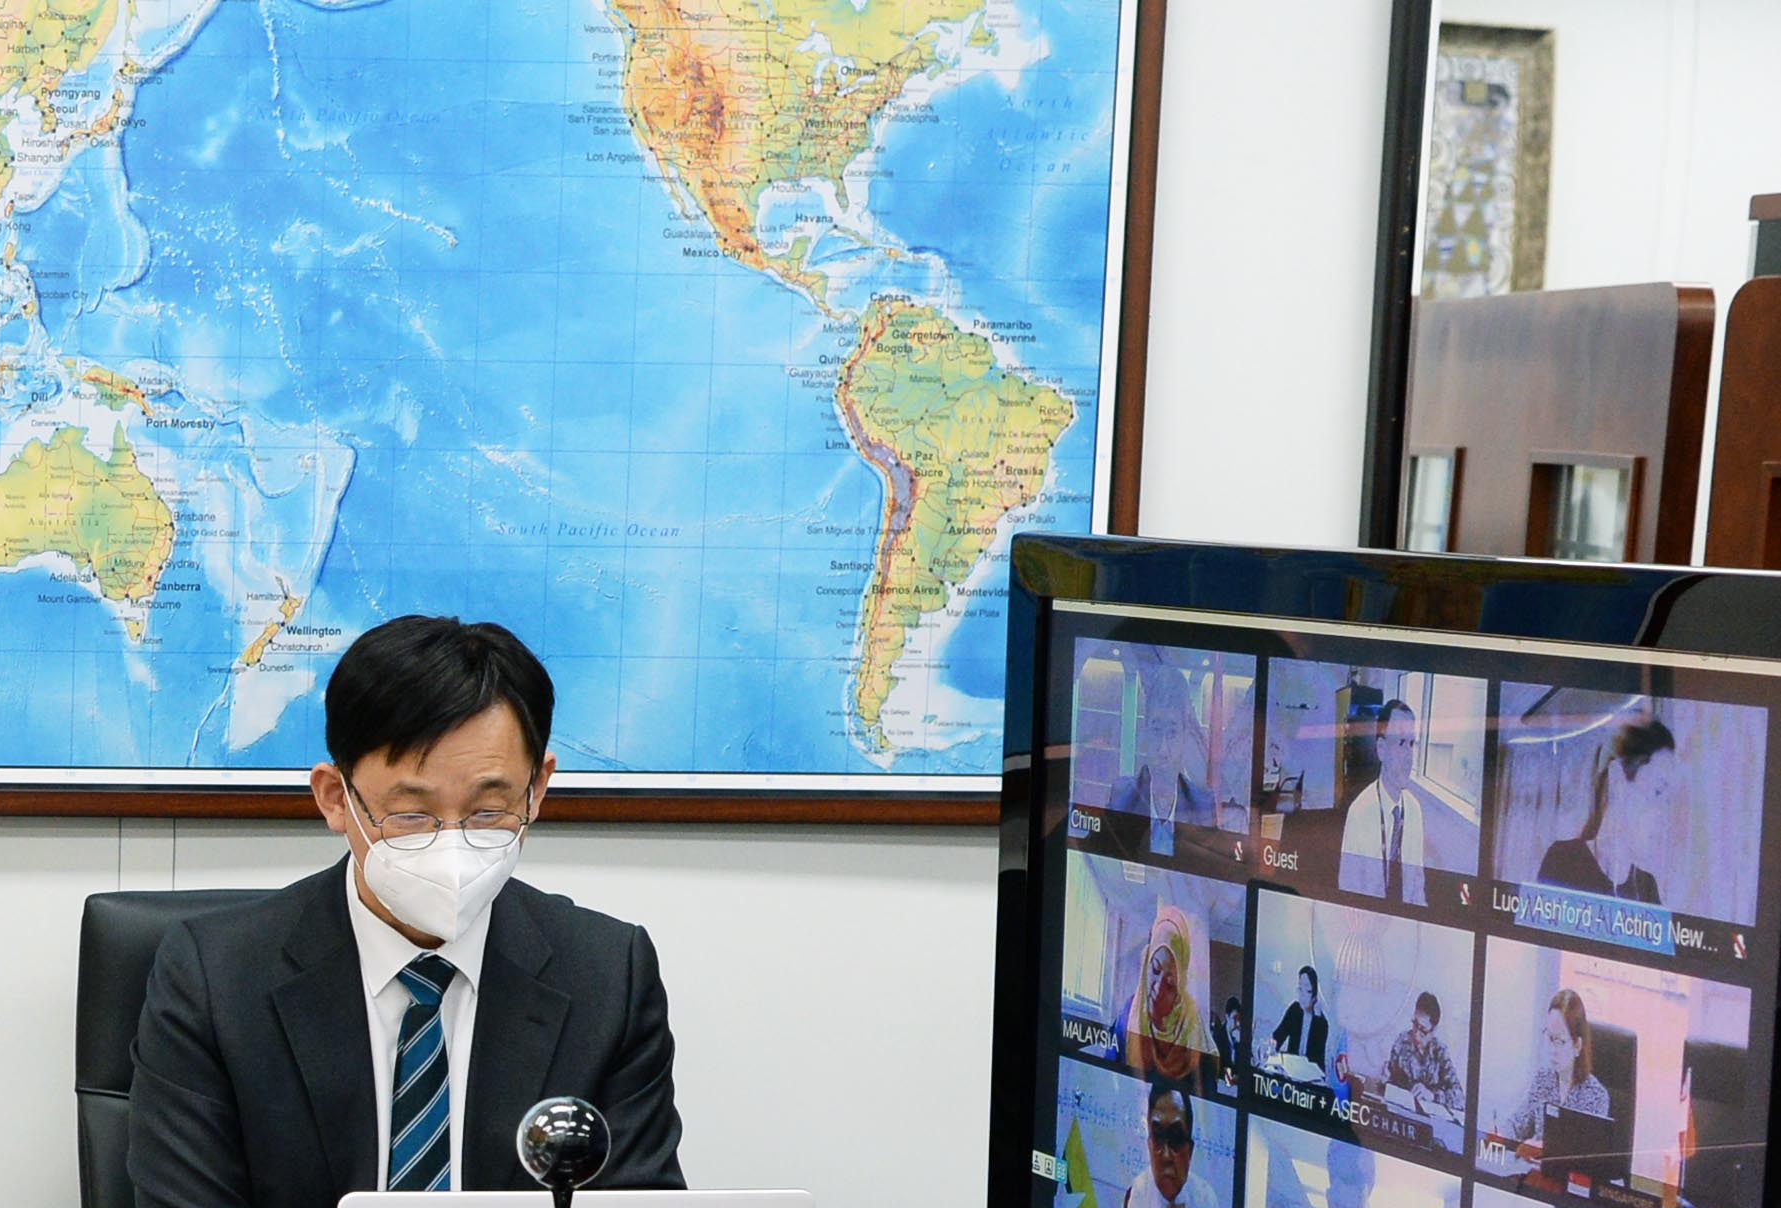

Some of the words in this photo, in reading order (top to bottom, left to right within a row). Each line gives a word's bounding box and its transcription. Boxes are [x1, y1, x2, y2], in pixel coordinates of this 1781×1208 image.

[841, 66, 876, 76] Ottawa
[41, 87, 101, 100] Pyongyang
[49, 103, 78, 114] Seoul
[56, 118, 88, 129] Pusan
[115, 117, 147, 129] Tokyo
[795, 213, 833, 223] Havana
[6, 221, 31, 232] Kong
[683, 248, 719, 258] Mexico
[722, 248, 742, 260] City
[973, 320, 1032, 330] Paramaribo
[992, 334, 1036, 345] Cayenne
[31, 392, 48, 402] Dili
[146, 419, 168, 429] Port
[170, 419, 215, 431] Moresby
[826, 440, 850, 450] Lima
[901, 452, 912, 460] La
[916, 452, 933, 461] Paz
[914, 468, 943, 478] Sucre
[173, 512, 216, 522] Brisbane
[498, 522, 548, 536] South
[558, 522, 618, 538] Pacific
[627, 523, 680, 537] Ocean
[165, 559, 200, 570] Sydney
[830, 560, 875, 571] Santiago
[154, 582, 201, 592] Canberra
[872, 585, 909, 595] Buenos
[914, 585, 940, 595] Aires
[246, 592, 283, 601] Hamilton
[130, 600, 181, 610] Melbourne
[286, 626, 341, 637] Wellington
[270, 642, 323, 652] Christchurch
[259, 664, 294, 673] Dunedin
[1071, 809, 1100, 832] China
[1263, 845, 1298, 871] Guest
[1493, 887, 1527, 918] Lucy
[1533, 895, 1592, 925] Ashford
[1611, 913, 1662, 944] Acting
[1062, 1019, 1119, 1052] MALAYSIA
[1253, 1073, 1279, 1099] TNC
[1282, 1081, 1315, 1110] Chair
[1330, 1095, 1370, 1126] ASEC
[1373, 1113, 1416, 1140] CHAIR
